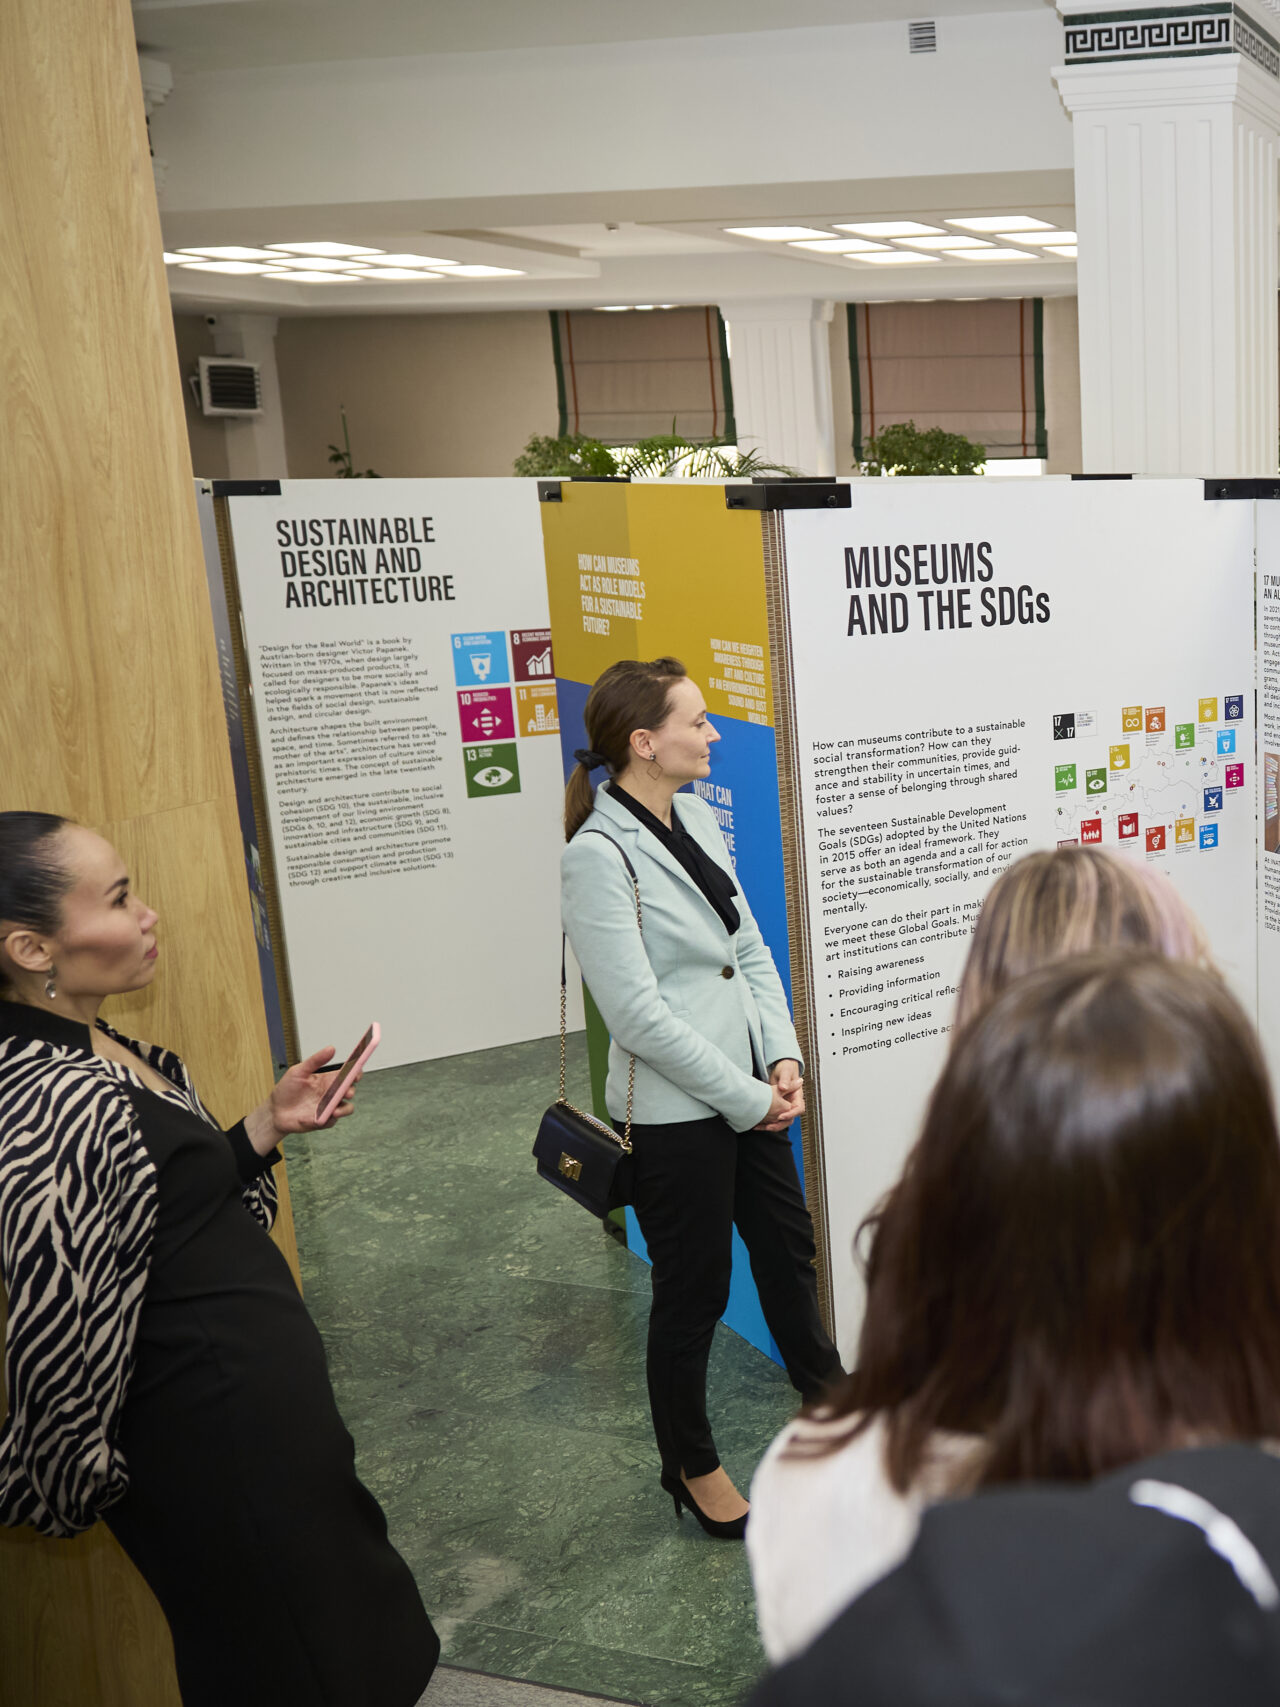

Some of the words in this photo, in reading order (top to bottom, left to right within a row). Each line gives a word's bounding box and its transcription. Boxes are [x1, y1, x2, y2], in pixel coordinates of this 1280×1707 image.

[276, 517, 435, 547] SUSTAINABLE
[281, 549, 367, 577] DESIGN
[376, 547, 421, 574] AND
[578, 554, 592, 571] HOW
[593, 555, 606, 572] CAN
[607, 556, 640, 576] MUSEUMS
[845, 542, 993, 588] MUSEUMS
[286, 575, 455, 608] ARCHITECTURE
[580, 574, 591, 591] ACT
[593, 576, 600, 592] AS
[602, 577, 618, 595] ROLE
[619, 579, 645, 599] MODELS
[1264, 575, 1269, 586] 17
[1264, 588, 1272, 598] AN
[581, 595, 593, 612] FOR
[595, 597, 599, 613] A
[600, 598, 642, 620] SUSTAINABLE
[848, 593, 908, 636] AND
[917, 589, 972, 630] THE
[981, 585, 1050, 627] SDGs
[513, 633, 520, 644] 8
[583, 616, 610, 636] FUTURE?
[460, 693, 471, 705] 10
[519, 689, 527, 700] 11
[1054, 716, 1061, 726] 17
[1067, 727, 1074, 737] 17
[813, 740, 834, 750] How
[838, 740, 854, 748] can
[858, 735, 902, 746] museums
[905, 727, 953, 741] contribute
[955, 726, 965, 736] to
[976, 720, 1025, 734] sustainable
[466, 749, 477, 761] 13
[814, 752, 843, 764] social
[846, 743, 925, 760] transformation?
[928, 742, 948, 752] How
[952, 742, 968, 750] can
[971, 738, 991, 749] they
[814, 764, 868, 778] strengthen
[871, 760, 894, 771] their
[897, 753, 959, 768] communities,
[962, 748, 995, 763] provide
[998, 745, 1020, 759] guid-
[815, 782, 838, 791] ance
[842, 776, 859, 788] and
[863, 772, 903, 785] stability
[906, 771, 914, 780] in
[918, 765, 961, 779] uncertain
[964, 763, 991, 773] times,
[994, 759, 1010, 770] and
[816, 792, 846, 803] foster
[858, 789, 885, 798] sense
[888, 784, 898, 795] of
[901, 780, 947, 793] belonging
[950, 774, 985, 787] through
[988, 770, 1018, 783] shared
[693, 780, 714, 801] WHAT
[716, 786, 732, 806] CAN
[817, 804, 853, 816] values?
[818, 827, 836, 837] The
[839, 821, 888, 834] seventeen
[891, 812, 945, 828] Sustainable
[949, 803, 1006, 820] Development
[819, 838, 847, 850] Goals
[850, 833, 883, 847] (SDGs)
[886, 827, 925, 841] adopted
[928, 826, 939, 837] by
[942, 823, 957, 834] the
[960, 818, 990, 831] United
[993, 815, 1026, 827] Nations
[825, 939, 839, 948] we
[842, 932, 866, 945] meet
[870, 929, 896, 940] these
[899, 921, 928, 935] Global
[931, 917, 959, 929] Goals.
[838, 965, 873, 978] Raising
[876, 957, 924, 972] awareness
[839, 982, 884, 997] Providing
[887, 972, 940, 989] information
[840, 999, 898, 1017] Encouraging
[901, 990, 933, 1005] critical
[841, 1021, 883, 1036] Inspiring
[886, 1018, 904, 1027] new
[908, 1012, 932, 1023] ideas
[843, 1039, 892, 1055] Promoting
[894, 1028, 942, 1045] collective
